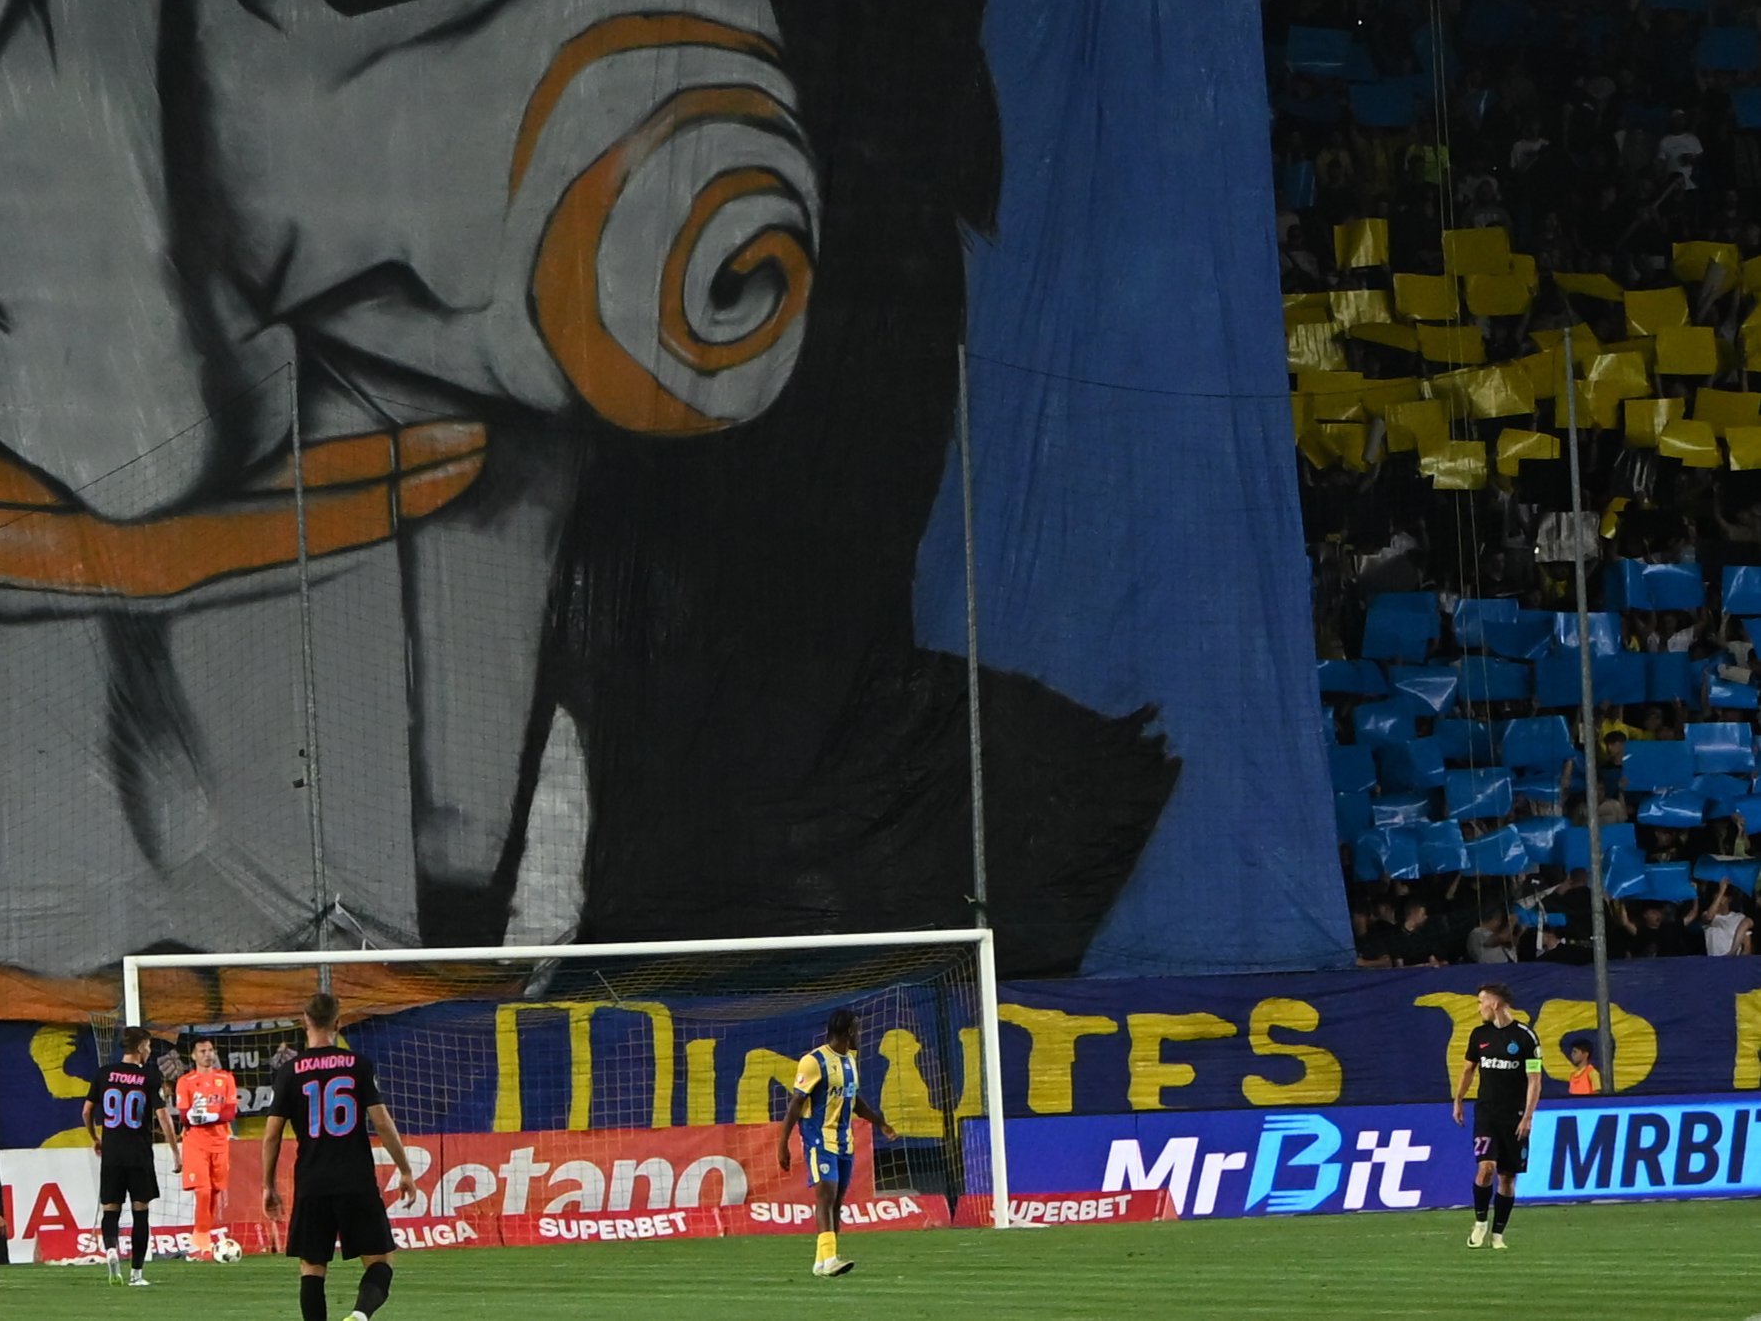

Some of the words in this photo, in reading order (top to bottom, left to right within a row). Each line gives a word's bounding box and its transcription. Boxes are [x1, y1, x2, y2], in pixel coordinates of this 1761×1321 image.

[294, 1054, 356, 1074] LIXANDRU
[102, 1087, 147, 1129] 90
[302, 1076, 357, 1138] 16
[1474, 1136, 1492, 1157] 27
[1548, 1108, 1761, 1191] MRBI
[1101, 1113, 1432, 1216] MrBit
[750, 1196, 922, 1225] SUPRLIGA
[77, 1227, 229, 1255] SPRBT
[392, 1221, 479, 1250] RLIGA
[538, 1210, 688, 1242] SUPERBET
